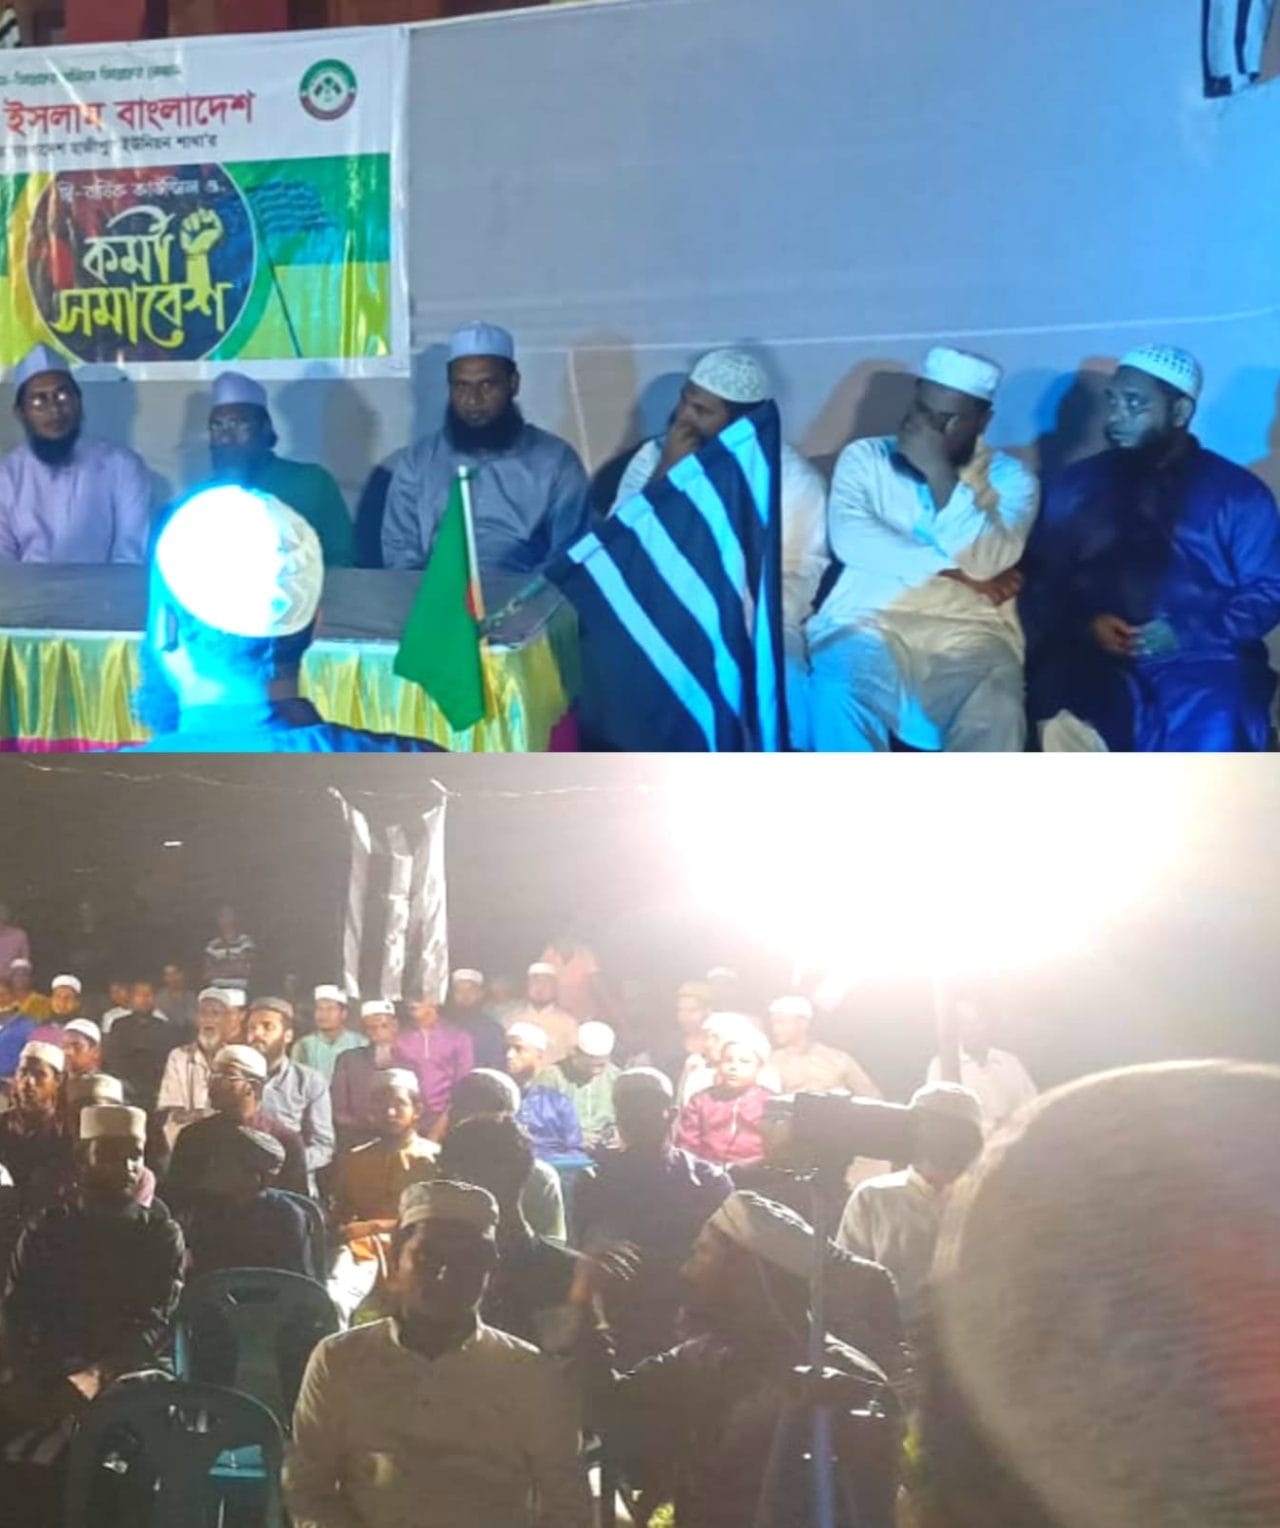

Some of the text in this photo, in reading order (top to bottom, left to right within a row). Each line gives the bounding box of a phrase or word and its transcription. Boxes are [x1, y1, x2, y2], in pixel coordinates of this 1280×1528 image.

[4, 97, 107, 136] ইসলাম
[113, 88, 256, 132] বাংলাদেশ
[82, 204, 176, 284] কর্মী
[50, 280, 235, 348] সমাবেশ
